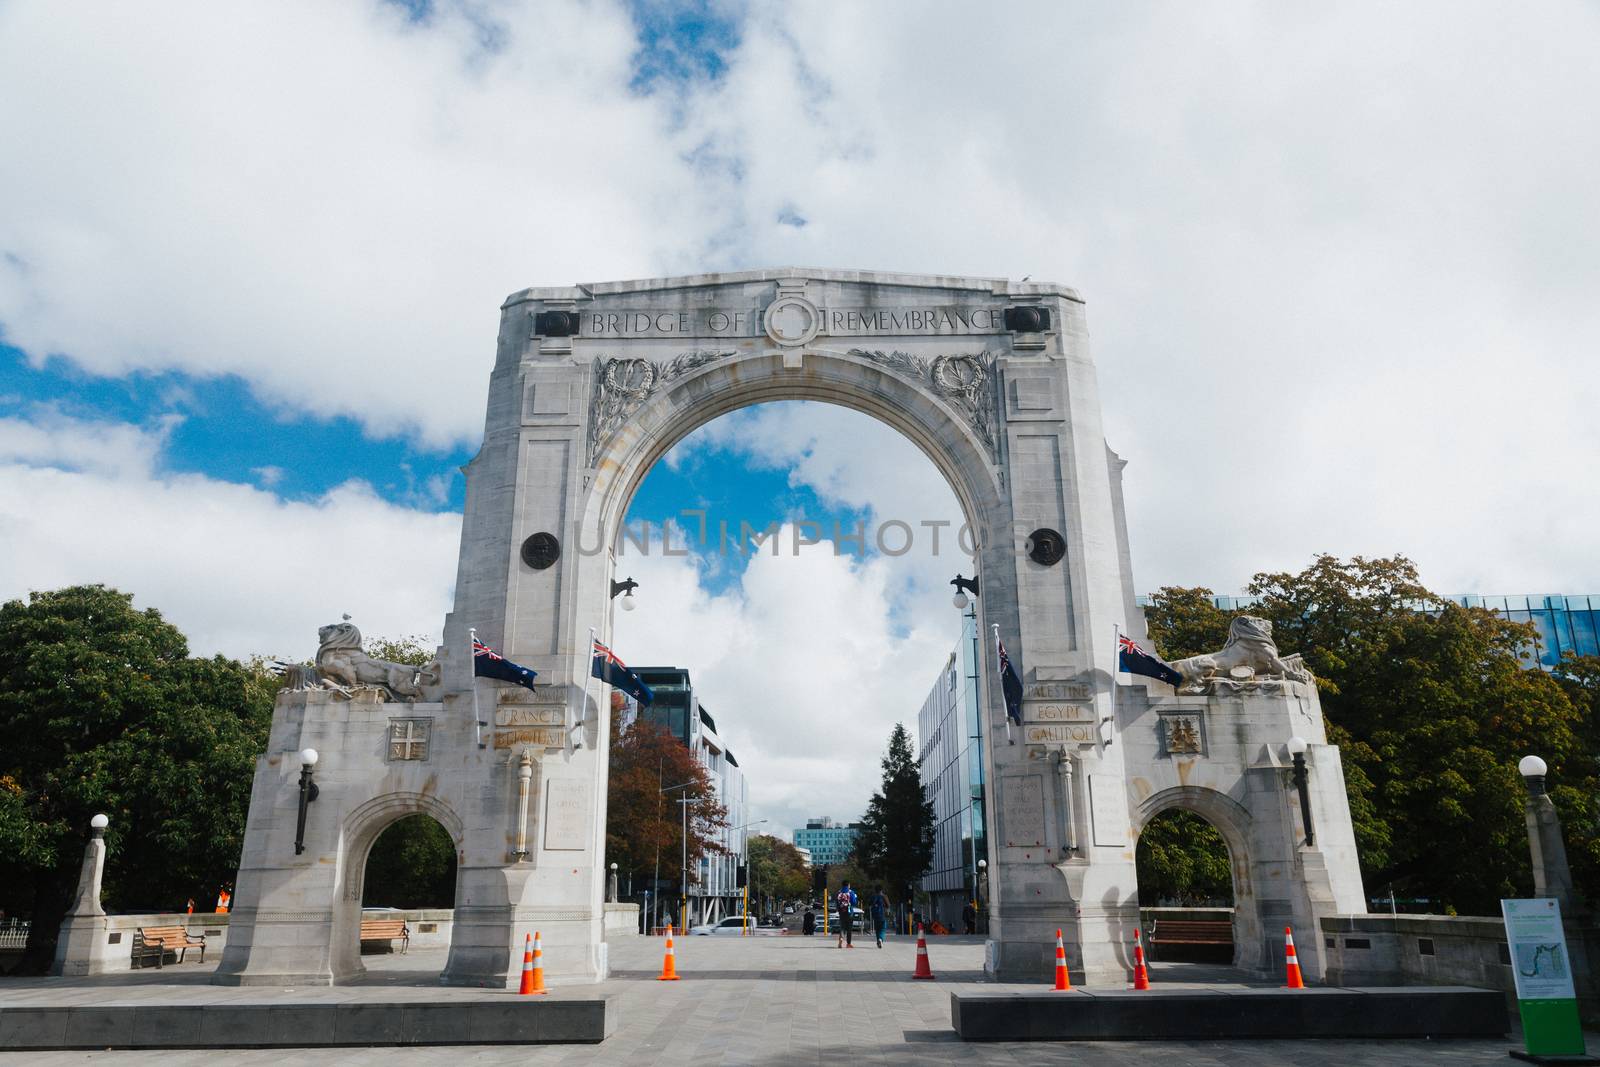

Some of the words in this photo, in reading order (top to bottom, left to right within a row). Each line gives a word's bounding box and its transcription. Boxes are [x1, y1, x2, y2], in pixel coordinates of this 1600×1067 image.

[591, 312, 688, 334] BRIDGE
[707, 311, 745, 333] OF
[832, 309, 1001, 332] REMEMBRANCE
[1027, 684, 1089, 698] PALESTINE
[501, 709, 560, 723] FRANCE
[1038, 705, 1081, 719] EGYPT
[1028, 726, 1094, 741] GALLIPOLI
